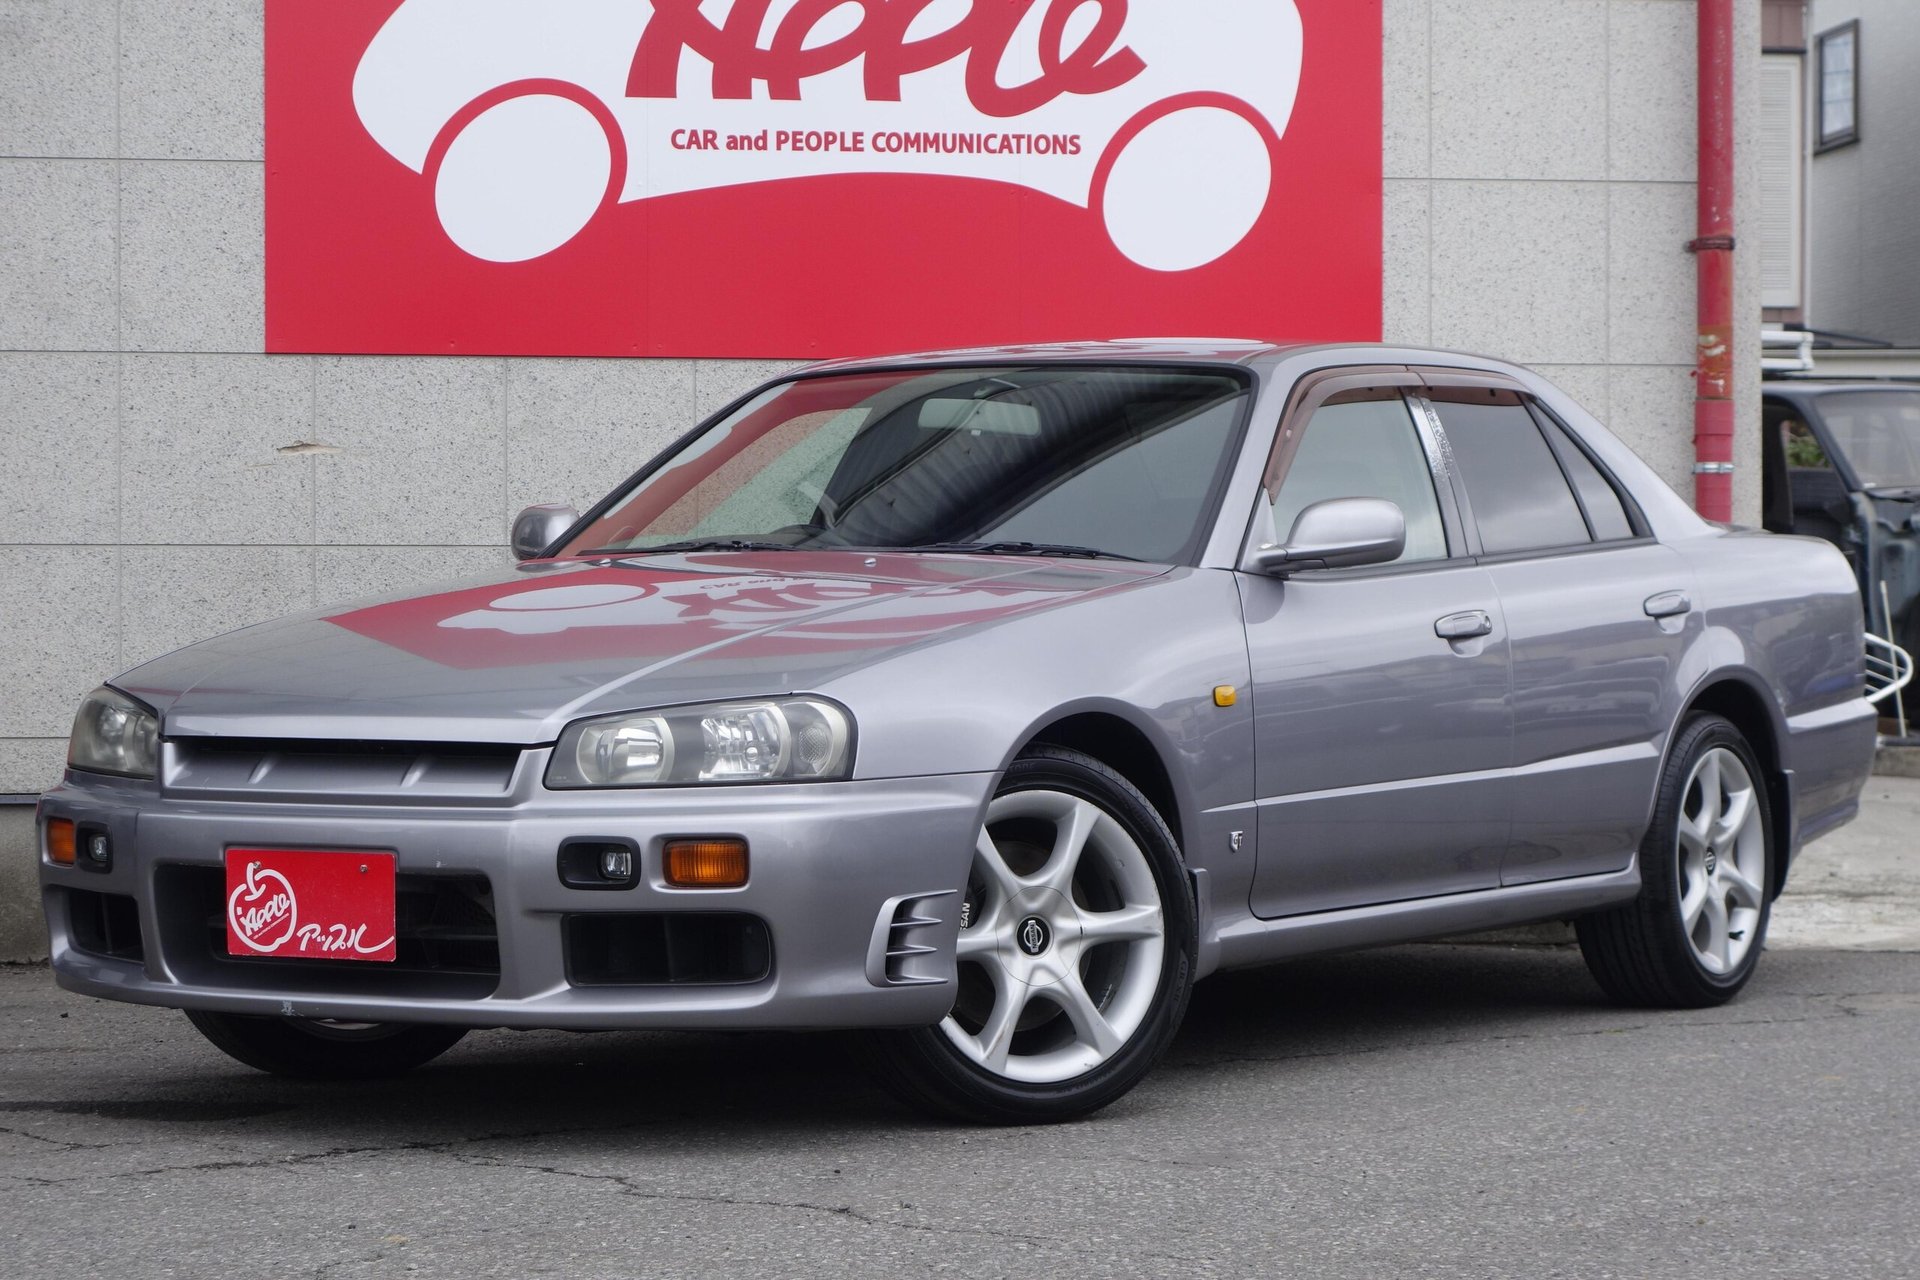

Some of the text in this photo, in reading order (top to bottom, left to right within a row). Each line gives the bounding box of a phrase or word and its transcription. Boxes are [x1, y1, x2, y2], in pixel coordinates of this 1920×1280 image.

[671, 129, 1082, 155] CAR and PEOPLE COMMUNICATIONS
[238, 893, 291, 937] Apple
[296, 923, 395, 954] アップル
